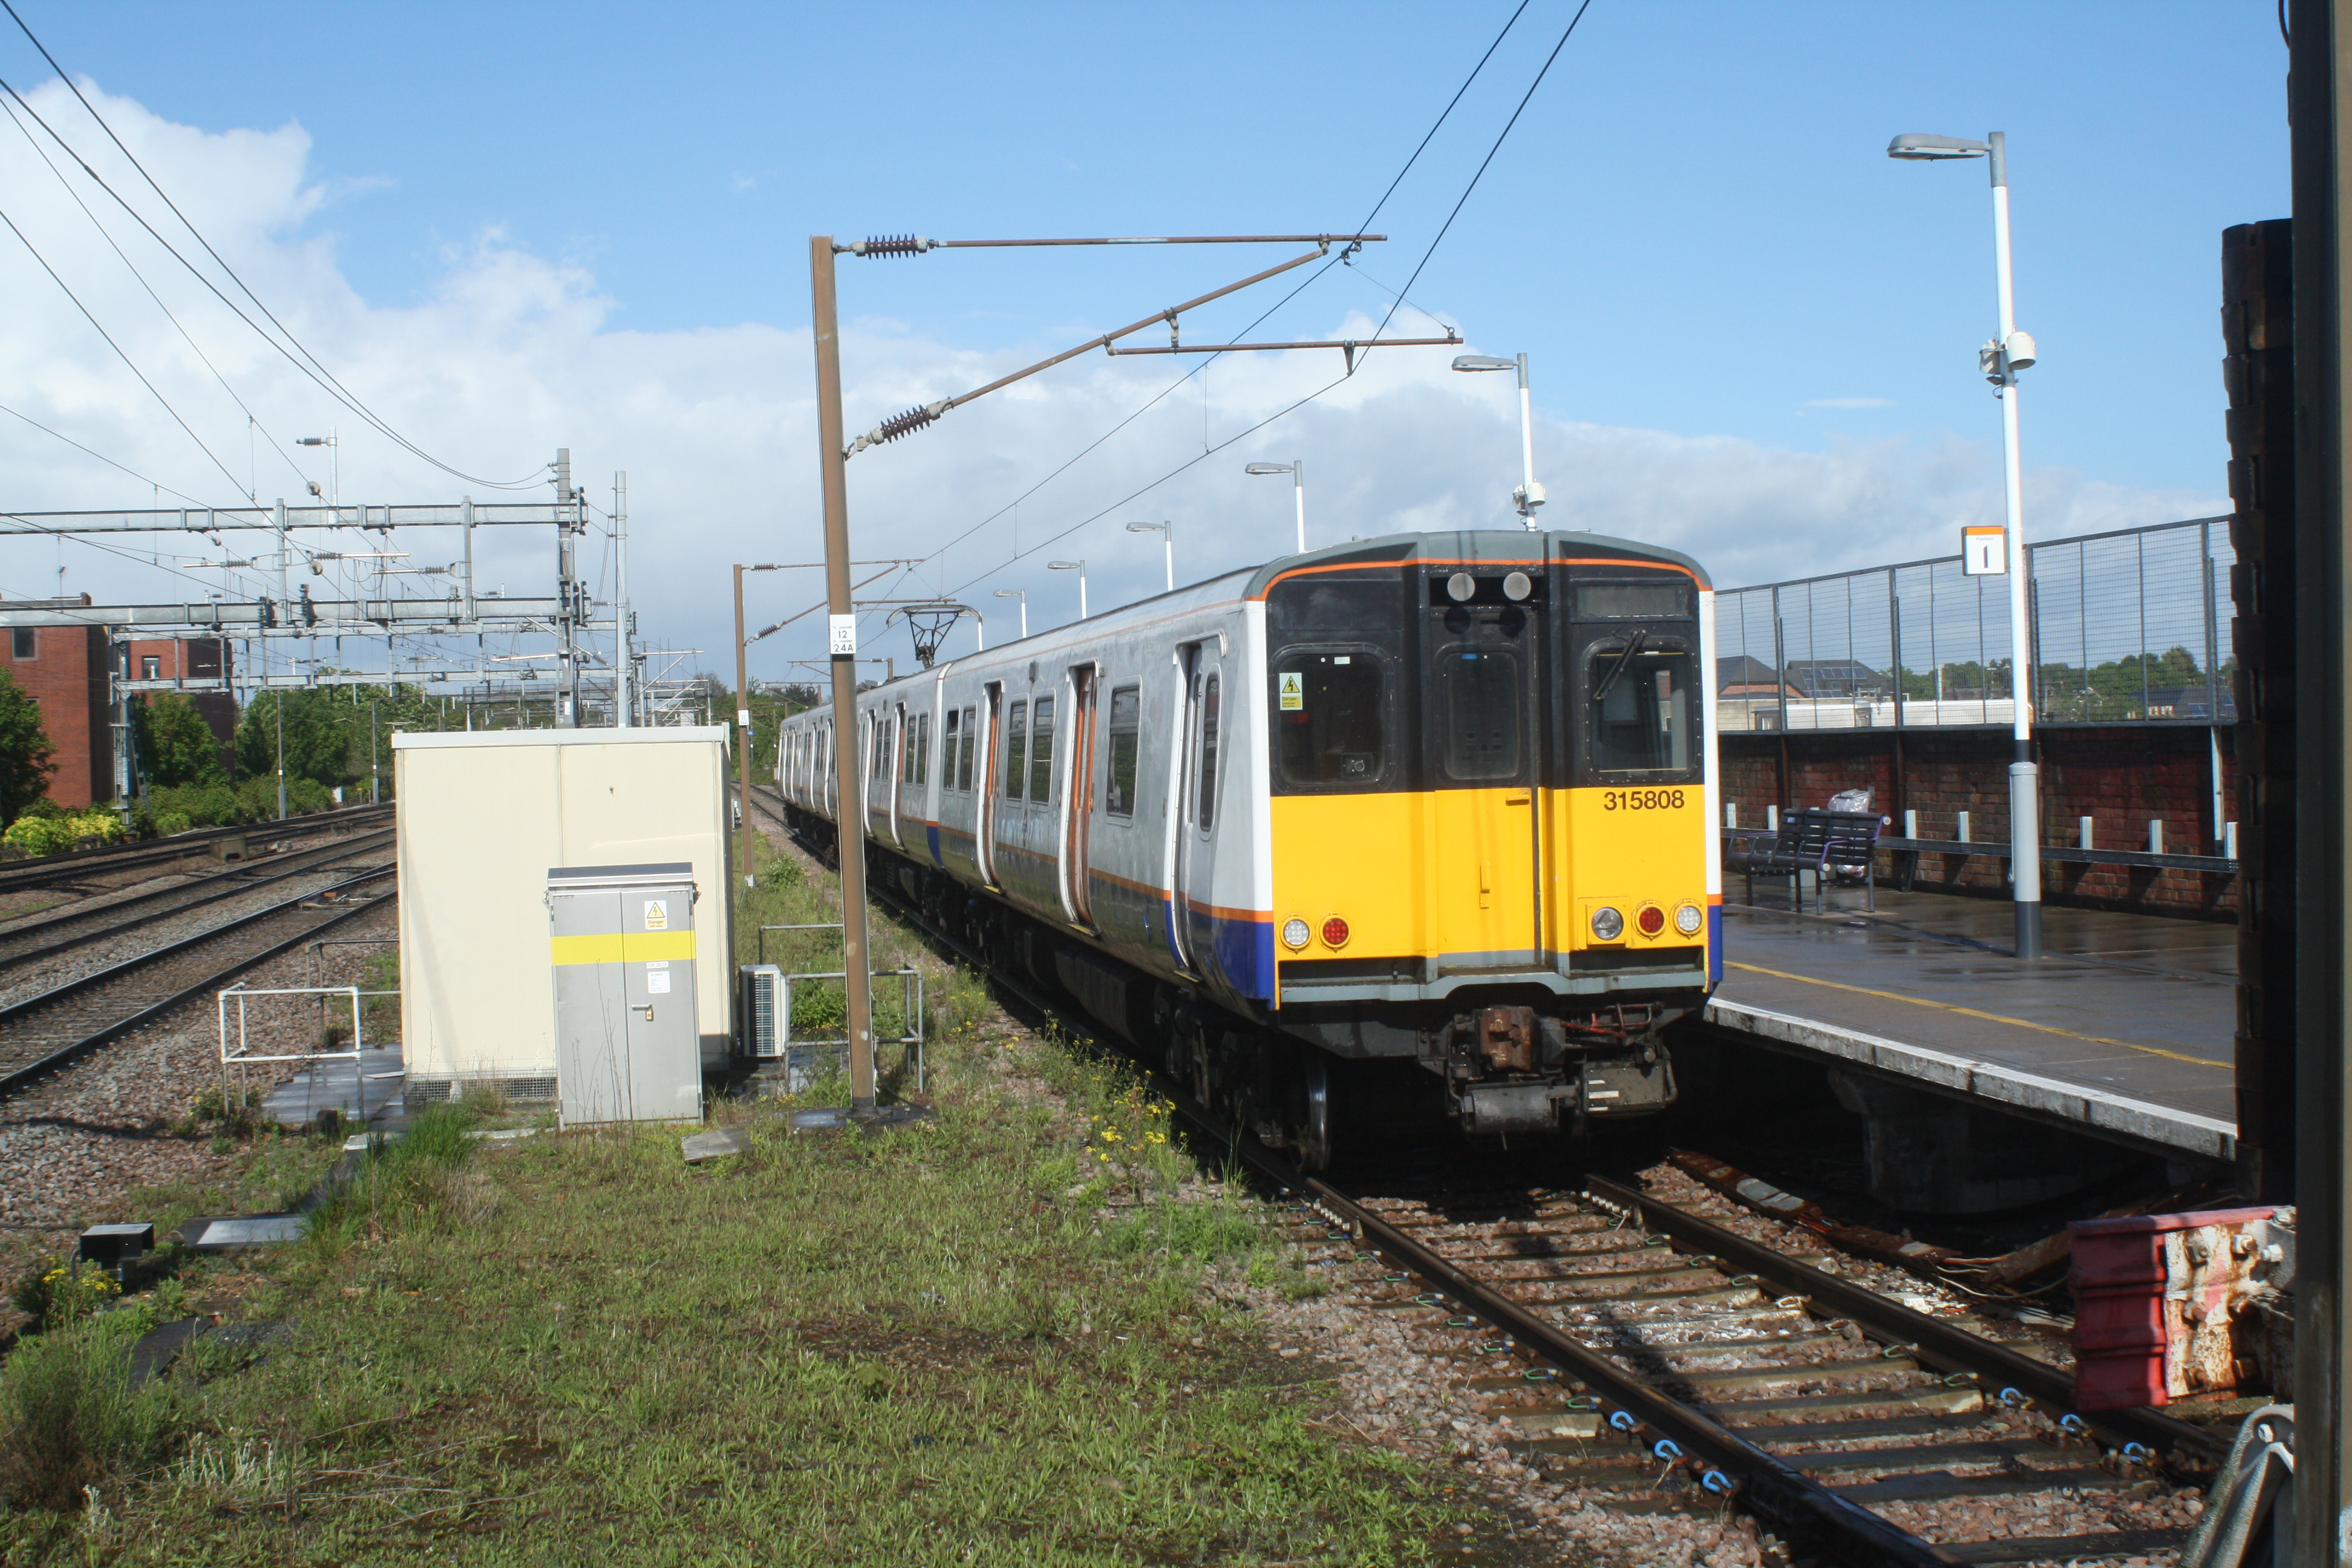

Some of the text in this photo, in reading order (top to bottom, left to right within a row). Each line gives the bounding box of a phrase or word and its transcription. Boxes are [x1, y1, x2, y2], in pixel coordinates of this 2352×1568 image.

[1983, 545, 1988, 569] 1
[838, 630, 848, 638] 12
[834, 644, 854, 652] 24A
[1604, 789, 1685, 811] 315808
